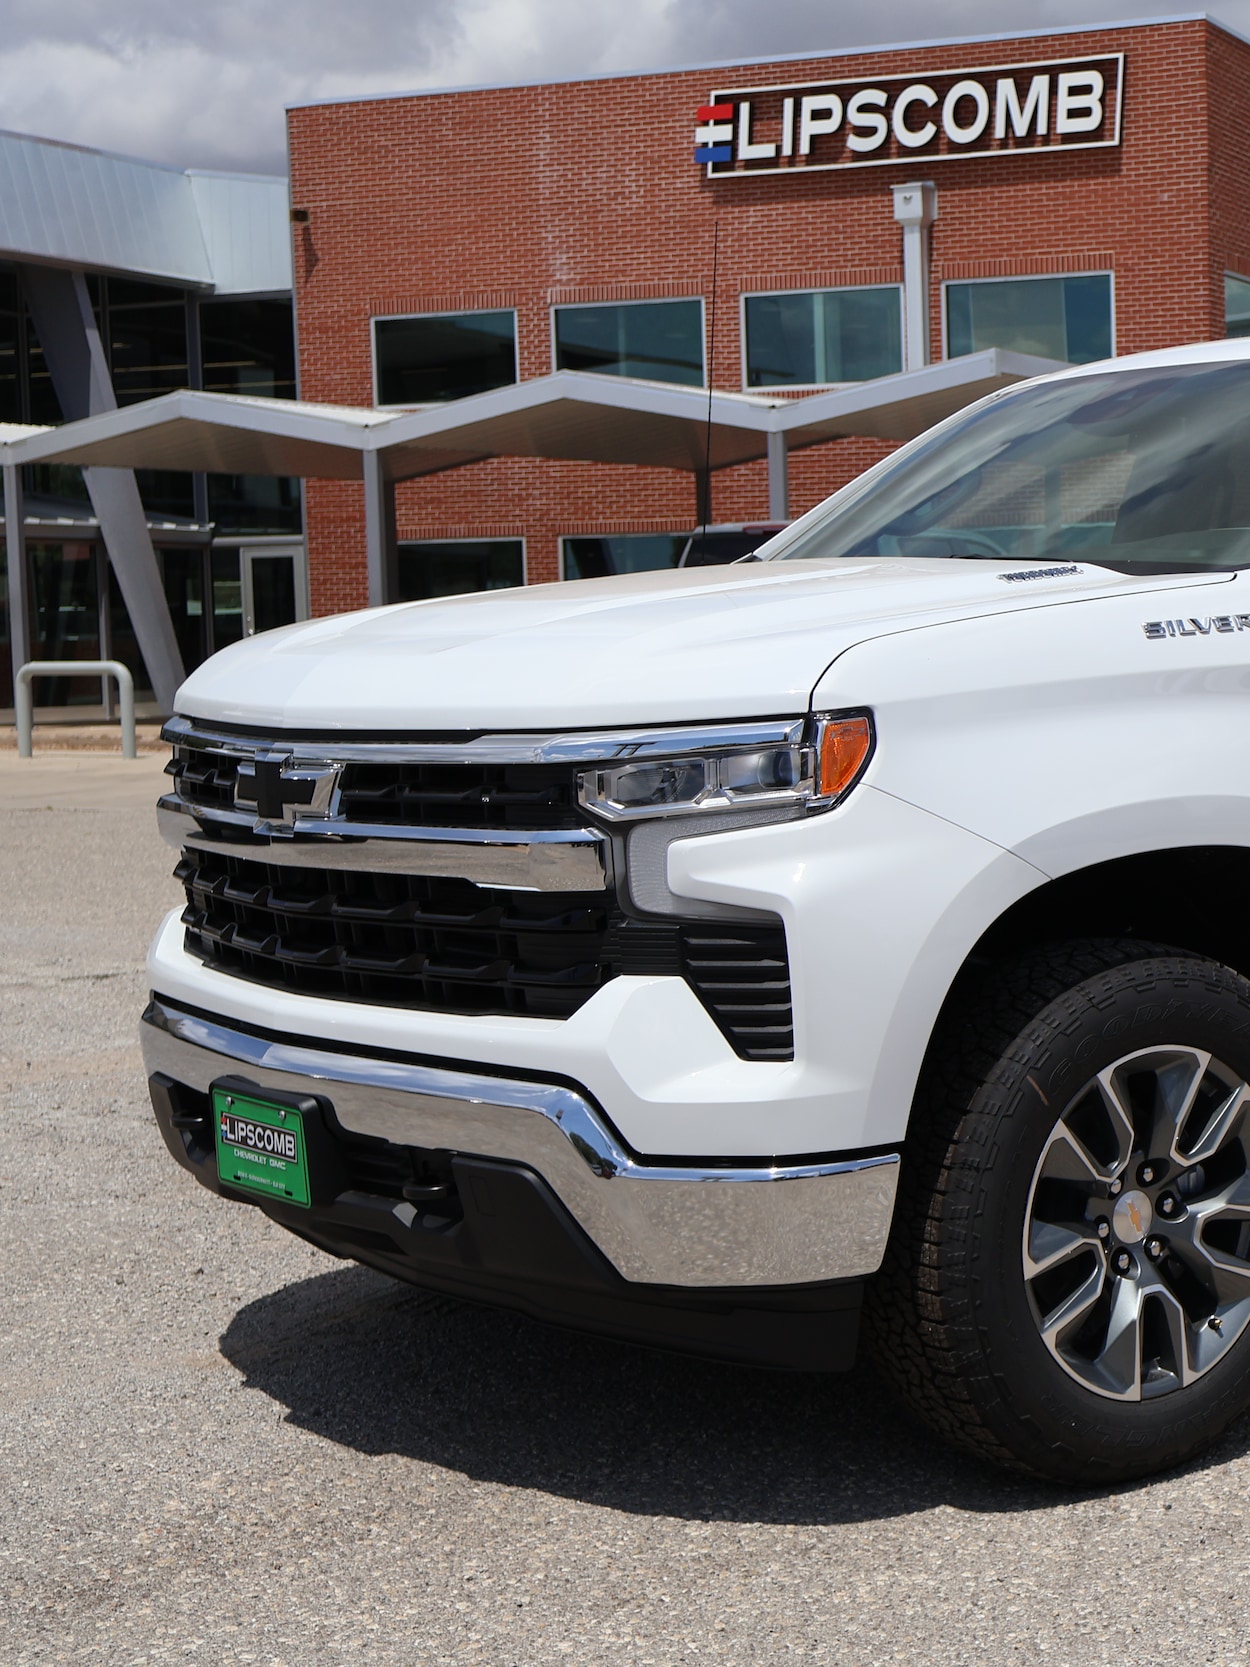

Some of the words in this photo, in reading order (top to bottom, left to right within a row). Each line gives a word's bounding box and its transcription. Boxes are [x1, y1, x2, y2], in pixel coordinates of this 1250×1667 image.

[737, 70, 1104, 161] LIPSCOMB
[226, 1118, 295, 1157] LIPSCOMB
[233, 1148, 267, 1165] CHEVROLET
[269, 1158, 287, 1170] GMC
